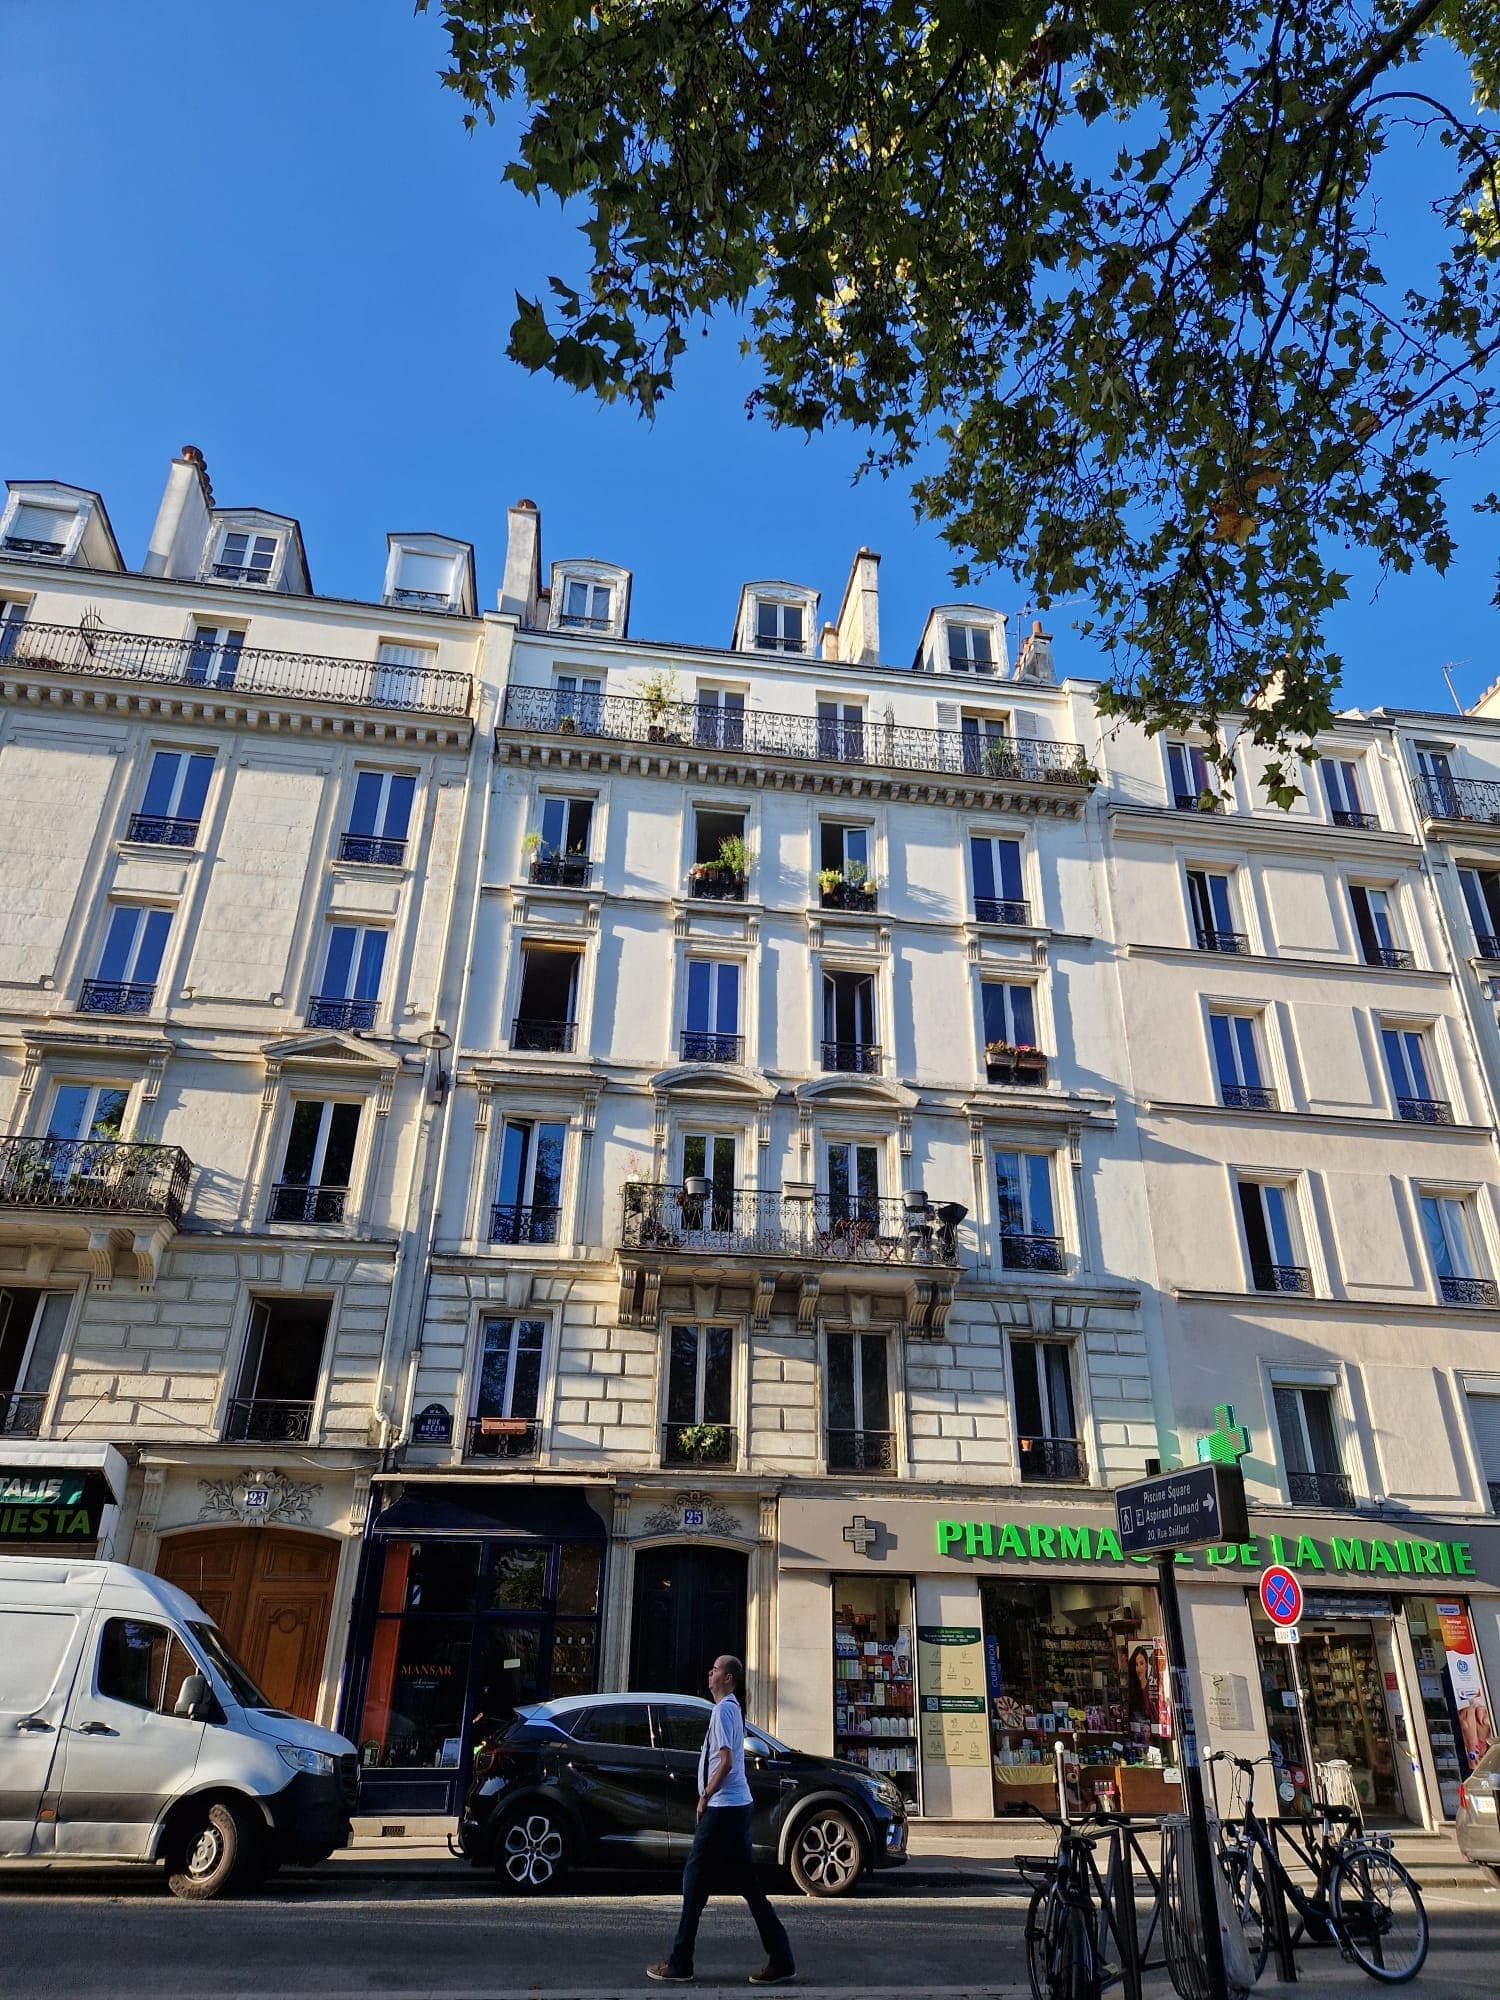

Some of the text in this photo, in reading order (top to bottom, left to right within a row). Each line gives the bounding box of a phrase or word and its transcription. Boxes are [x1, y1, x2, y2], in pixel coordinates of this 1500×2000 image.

[248, 1491, 266, 1505] 23
[1143, 1484, 1191, 1505] Piscine Square
[686, 1510, 702, 1524] 25
[1145, 1498, 1199, 1525] Aspirant Dunand
[1157, 1528, 1168, 1539] Rue
[936, 1520, 1195, 1563] PHARMA
[1270, 1533, 1325, 1569] LA
[1331, 1536, 1477, 1575] MAIRIE
[401, 1664, 452, 1676] MANSAR
